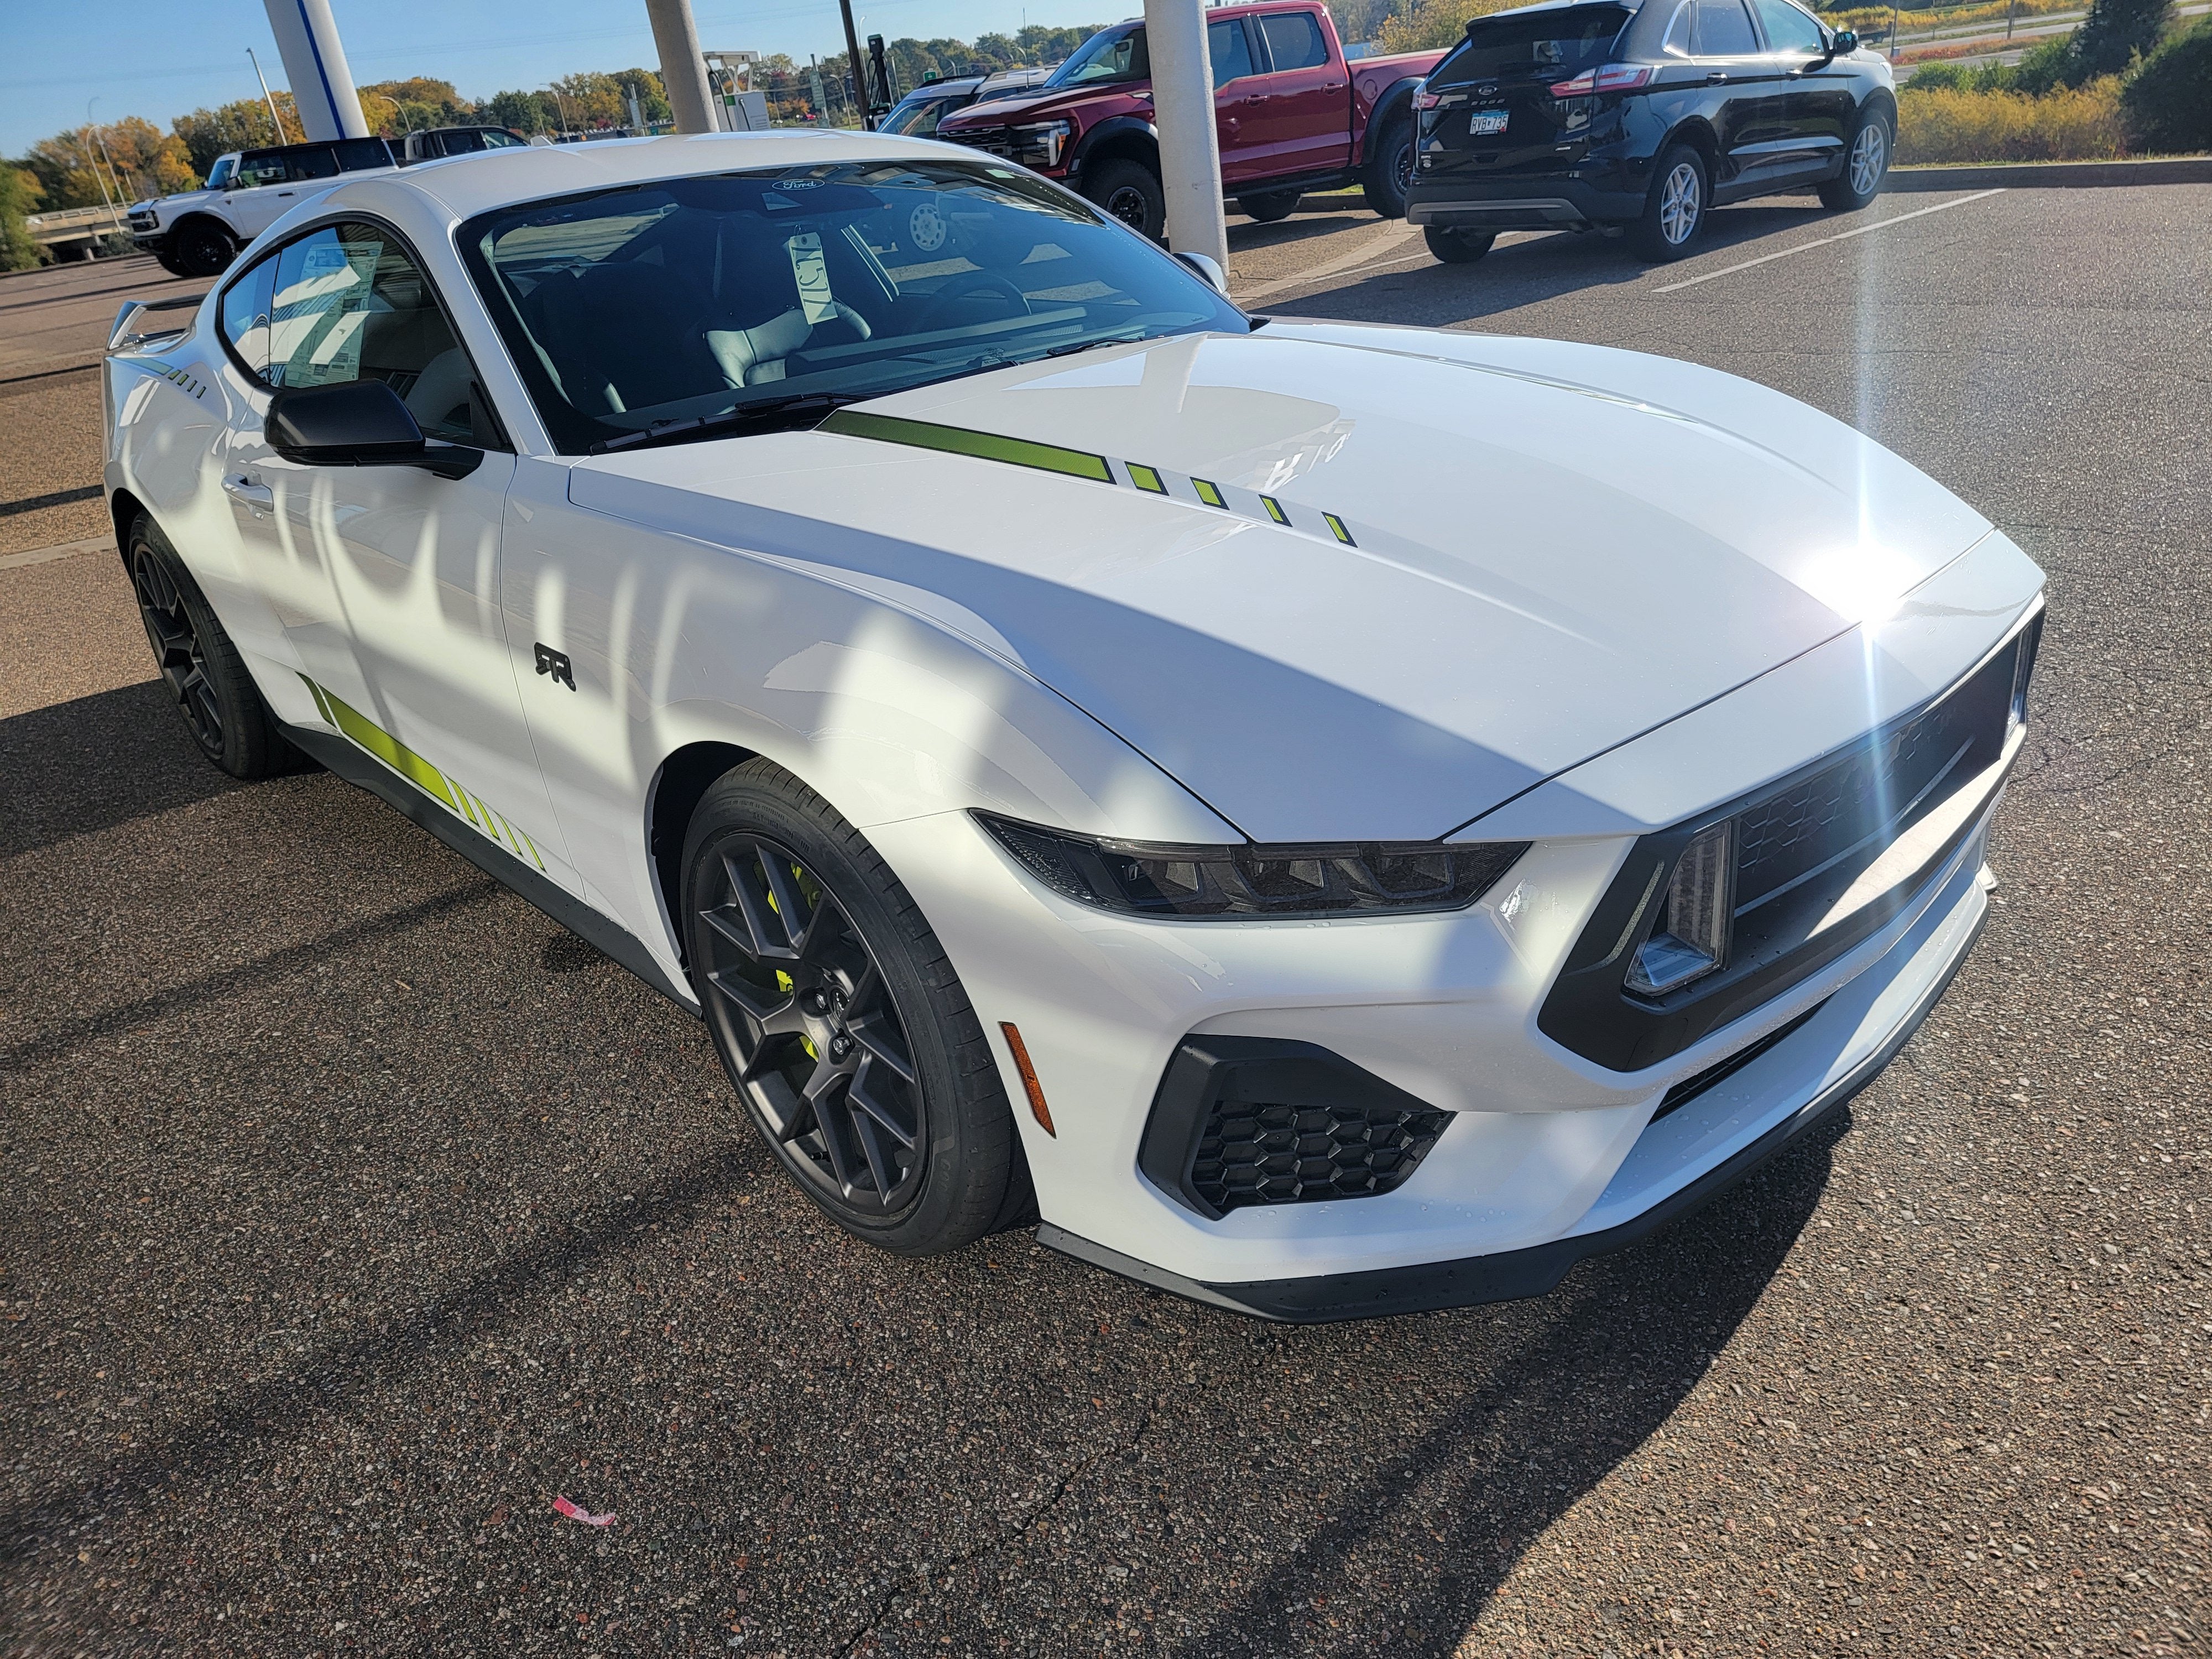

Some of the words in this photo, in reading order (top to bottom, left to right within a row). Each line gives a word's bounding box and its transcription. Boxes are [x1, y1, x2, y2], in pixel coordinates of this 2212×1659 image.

[1472, 118, 1487, 131] RVB
[1492, 116, 1507, 129] 735
[783, 180, 817, 189] Ford
